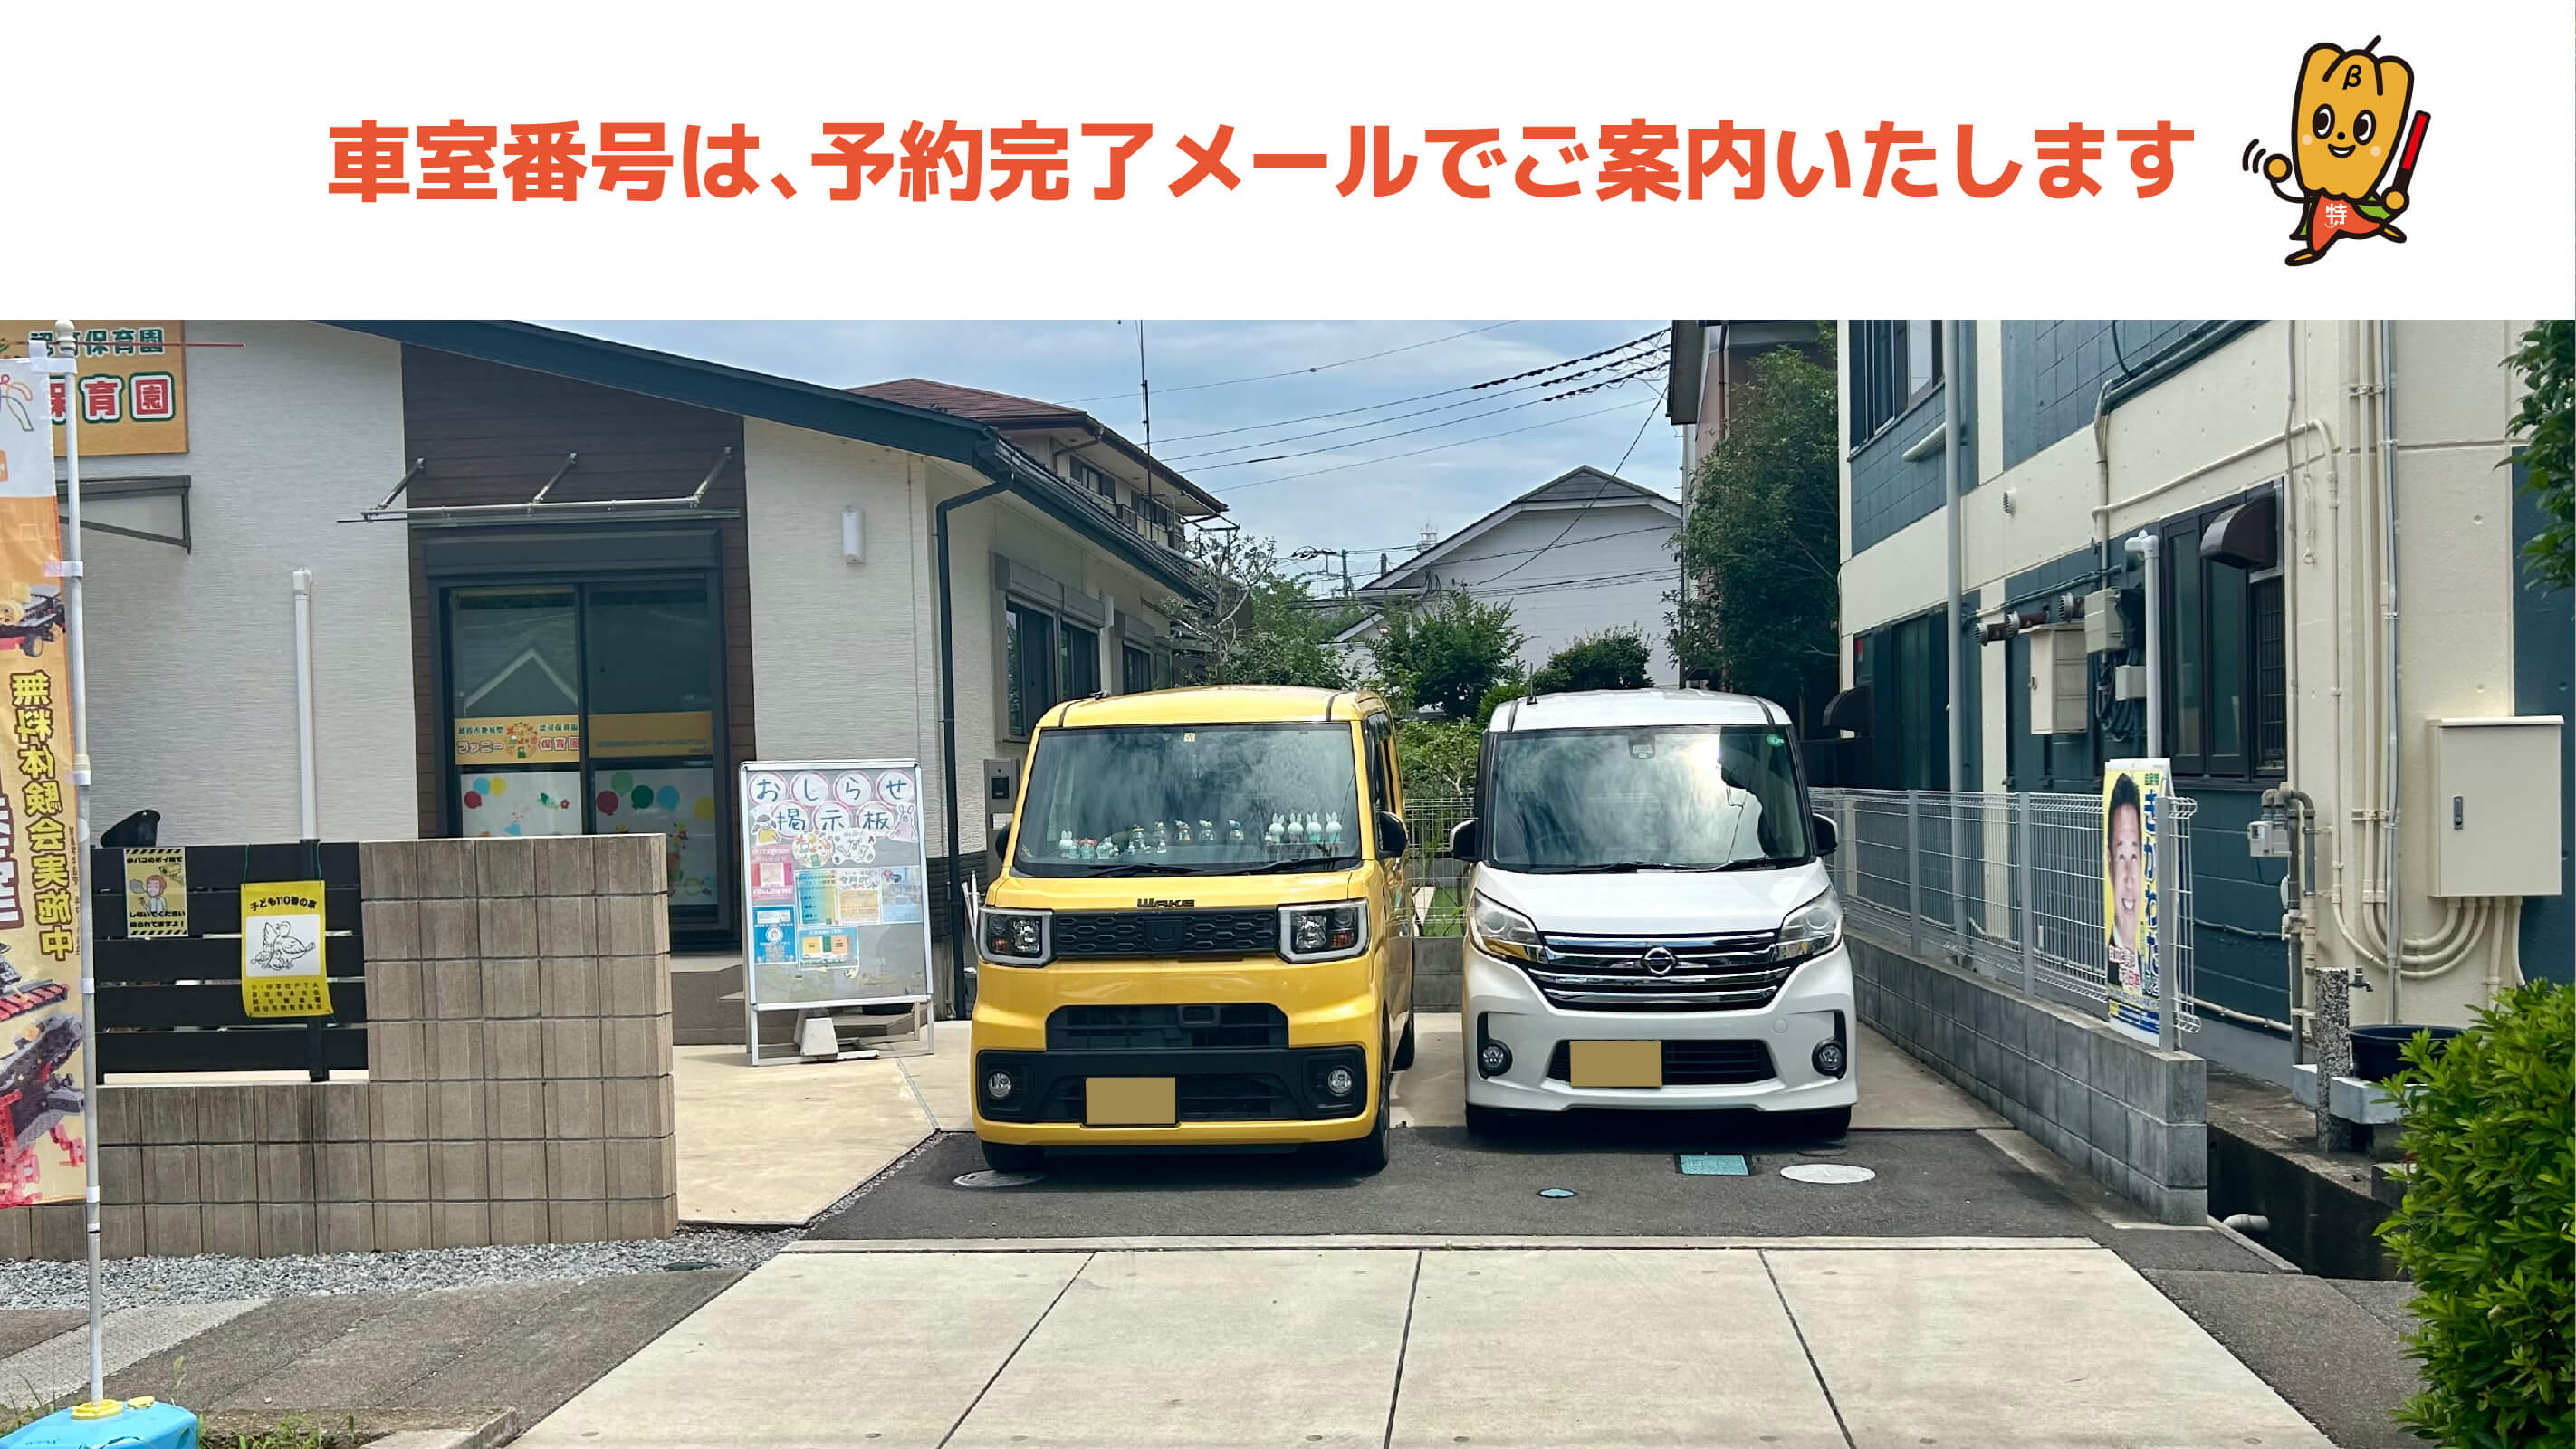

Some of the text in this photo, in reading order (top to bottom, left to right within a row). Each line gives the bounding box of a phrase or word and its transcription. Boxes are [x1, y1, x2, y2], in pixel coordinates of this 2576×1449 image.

[30, 329, 164, 355] 認保育園
[756, 777, 908, 803] おしらせ
[776, 807, 892, 831] 掲示板
[250, 896, 318, 912] 子ども110番の家
